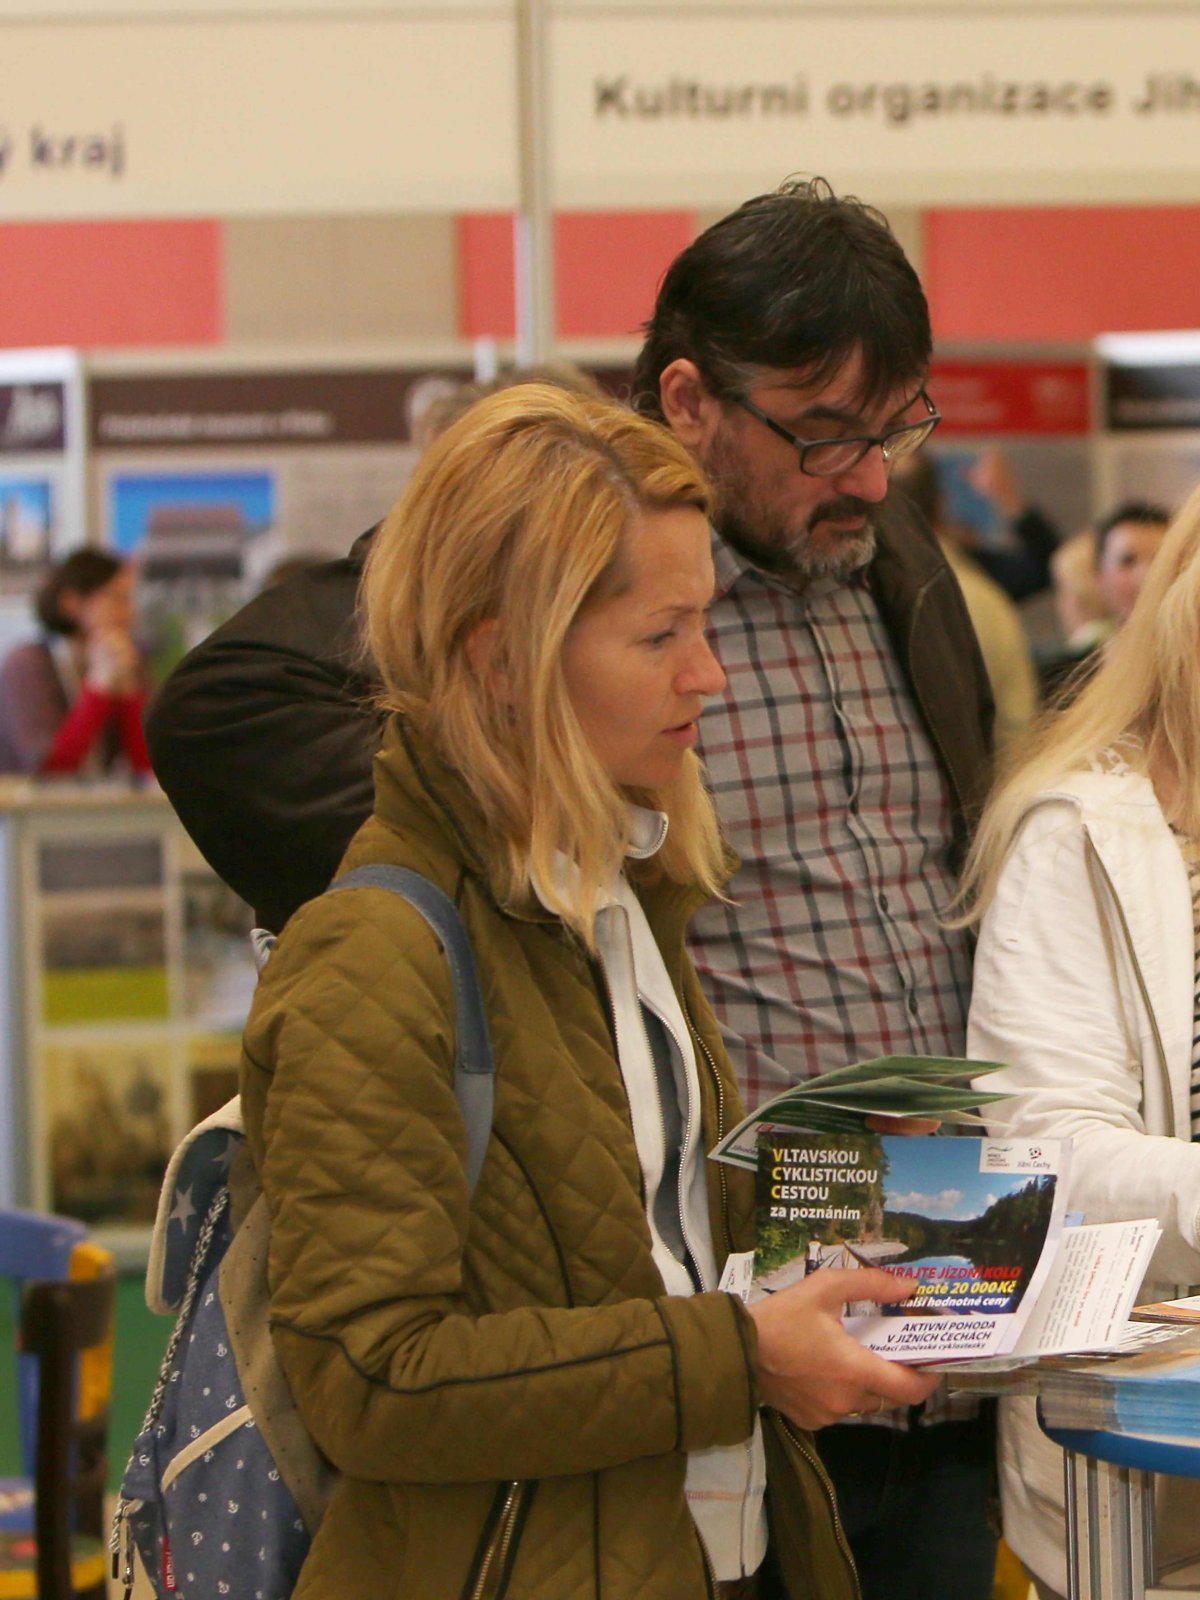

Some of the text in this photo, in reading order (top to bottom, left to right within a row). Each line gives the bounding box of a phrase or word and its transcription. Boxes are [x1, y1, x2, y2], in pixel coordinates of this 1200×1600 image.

[824, 72, 1110, 129] organizace
[29, 122, 126, 178] kraj
[772, 1148, 860, 1165] VLTAVSKOU
[771, 1166, 878, 1184] CYKLISTICKOU
[771, 1184, 829, 1201] CESTOU
[769, 1204, 861, 1221] za poznáním
[880, 1265, 936, 1279] HRAJTE
[984, 1266, 1023, 1279] KOLO
[950, 1281, 969, 1295] 20
[970, 1280, 998, 1294] 000
[926, 1295, 981, 1307] hodnotné
[982, 1296, 1010, 1308] ceny
[948, 1320, 996, 1331] POHODA
[887, 1334, 895, 1343] V
